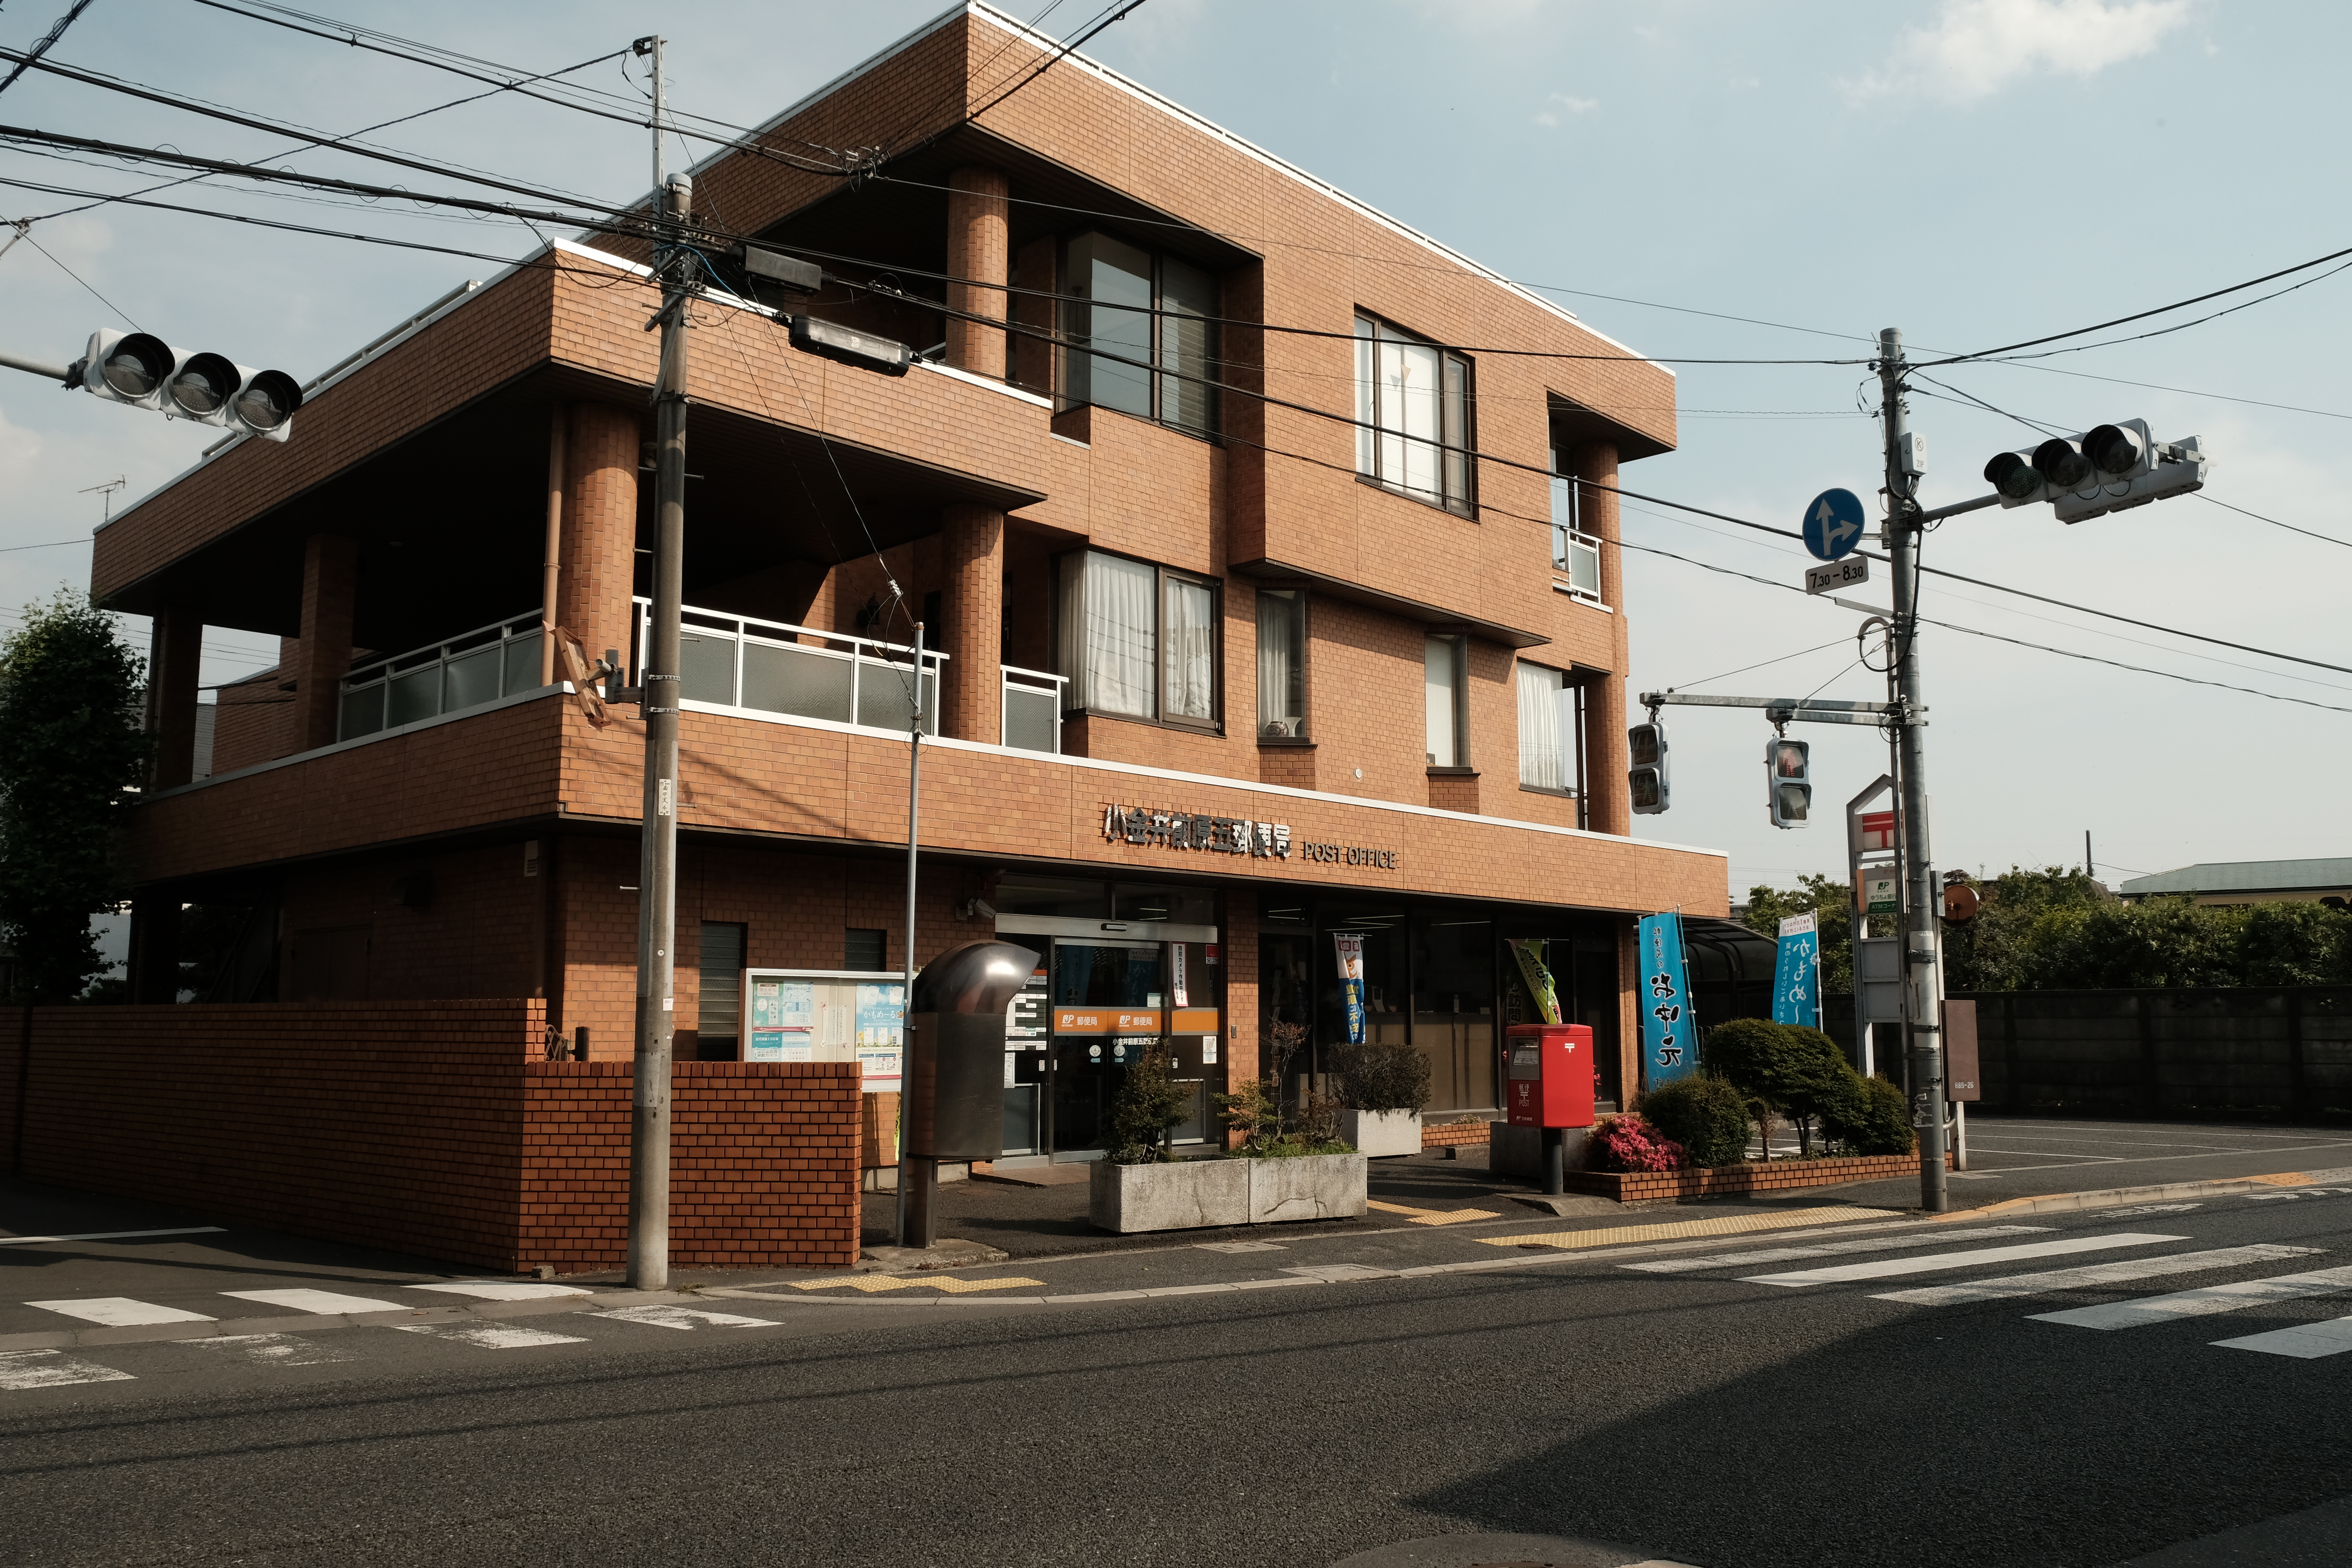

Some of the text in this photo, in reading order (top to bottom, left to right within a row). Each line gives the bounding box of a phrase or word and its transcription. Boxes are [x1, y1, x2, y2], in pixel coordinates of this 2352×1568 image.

[1105, 803, 1291, 858] 小金井前原五郵便局
[1305, 841, 1398, 869] POST OFFICE
[1077, 1016, 1097, 1025] 郵便局
[1133, 1017, 1152, 1025] 郵便局
[1519, 1083, 1530, 1093] 郵便
